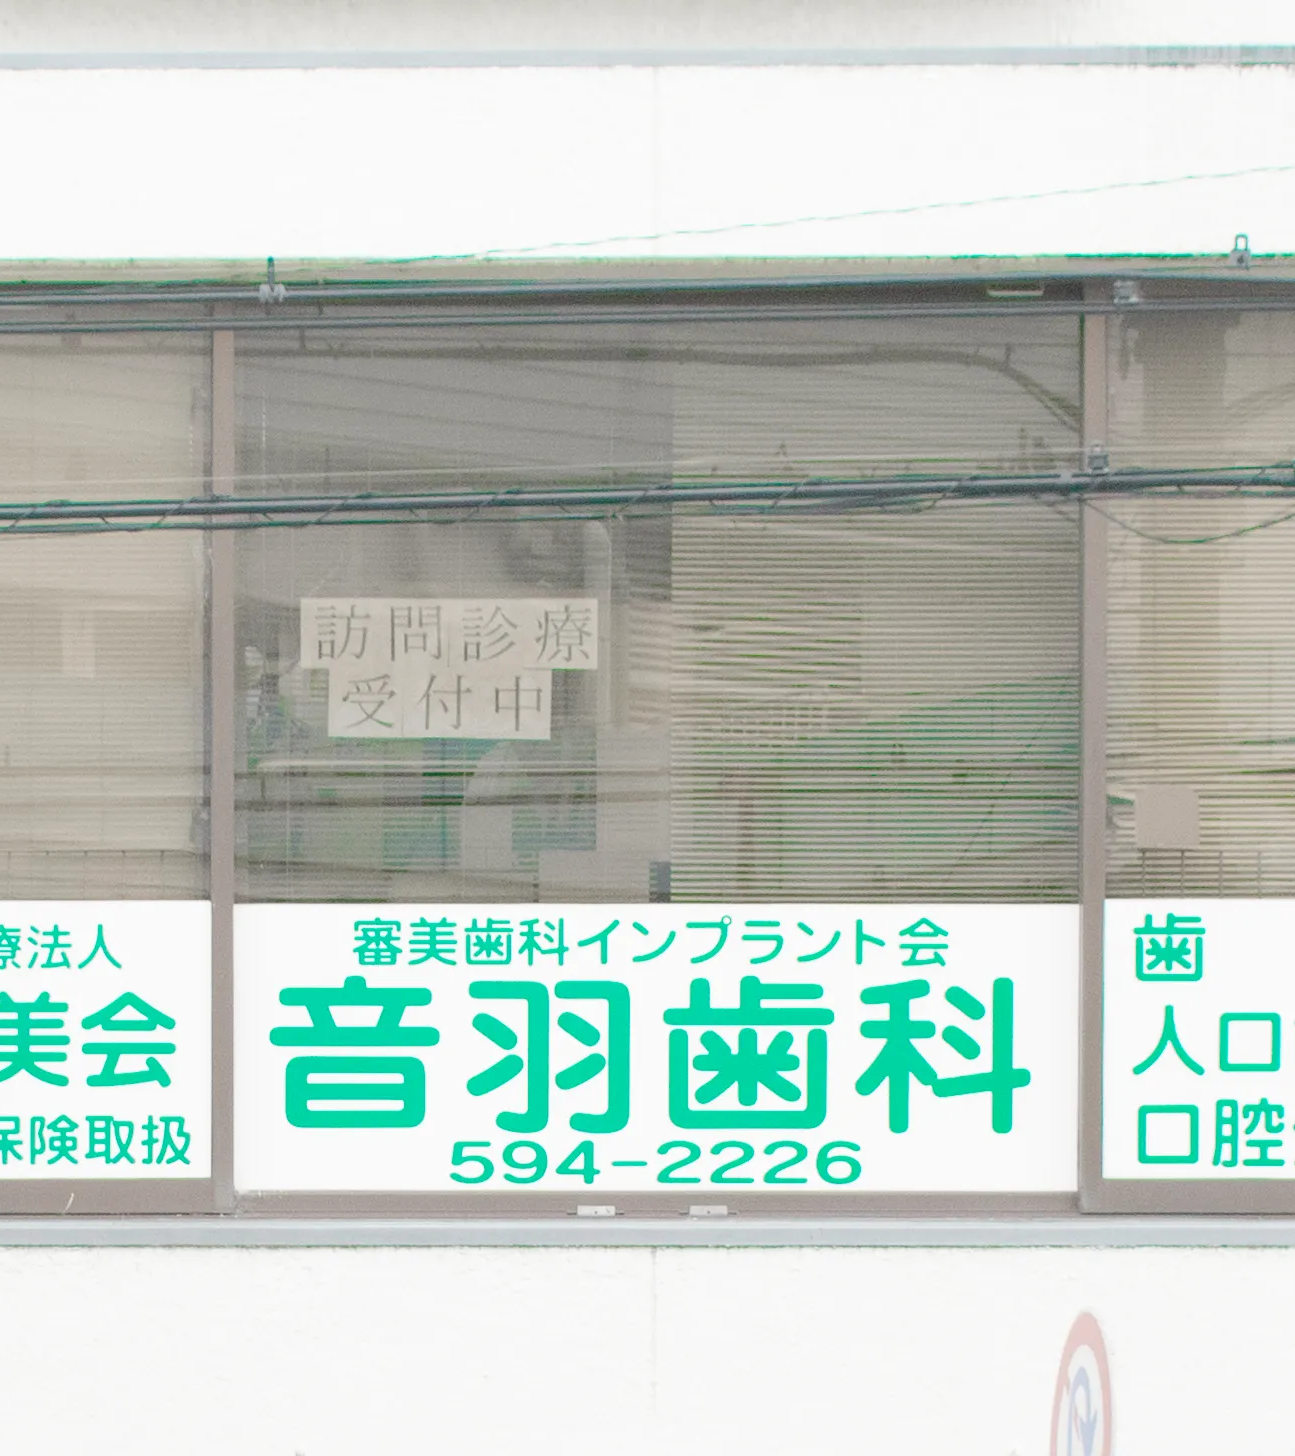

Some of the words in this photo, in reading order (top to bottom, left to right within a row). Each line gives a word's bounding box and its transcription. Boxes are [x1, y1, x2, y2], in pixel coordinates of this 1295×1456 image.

[314, 604, 593, 662] 訪問診療
[342, 673, 543, 732] 受付中
[353, 917, 949, 967] 審美歯科インプラント会
[270, 975, 1031, 1134] 音羽歯科
[449, 1140, 863, 1184] 594-2226
